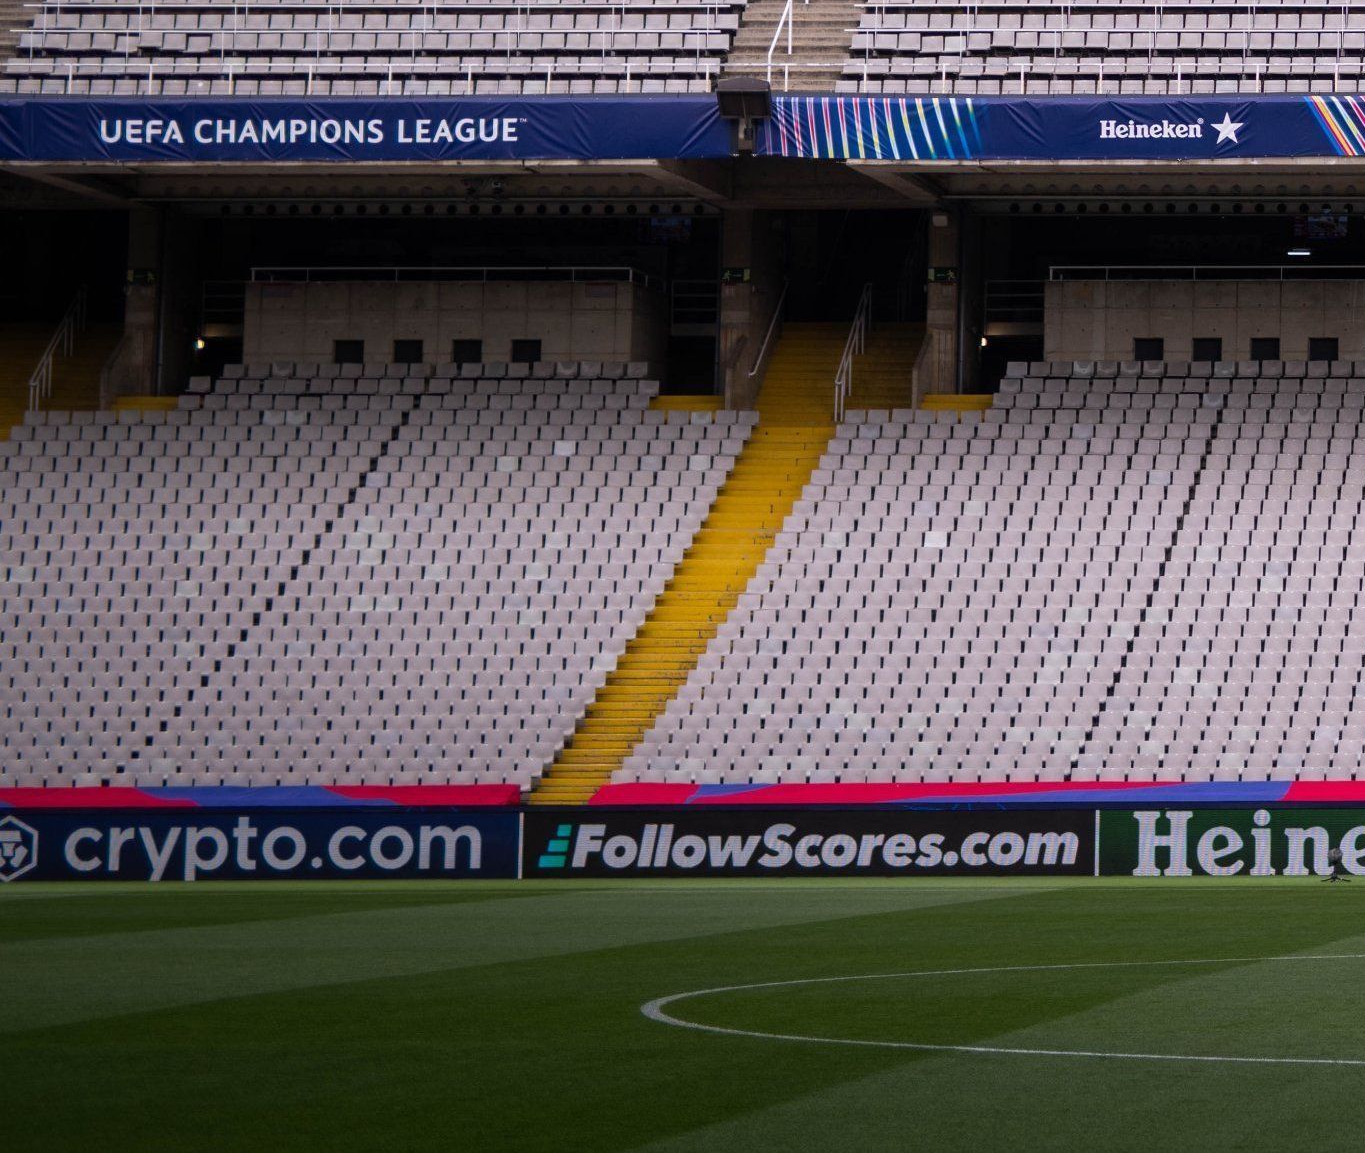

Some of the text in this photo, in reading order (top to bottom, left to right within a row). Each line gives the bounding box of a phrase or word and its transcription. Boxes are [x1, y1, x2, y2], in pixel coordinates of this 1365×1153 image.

[100, 119, 184, 144] UEFA
[194, 119, 384, 144] CHAMPIONS
[64, 816, 483, 882] crypto.com
[572, 823, 1079, 868] FollowScores.com
